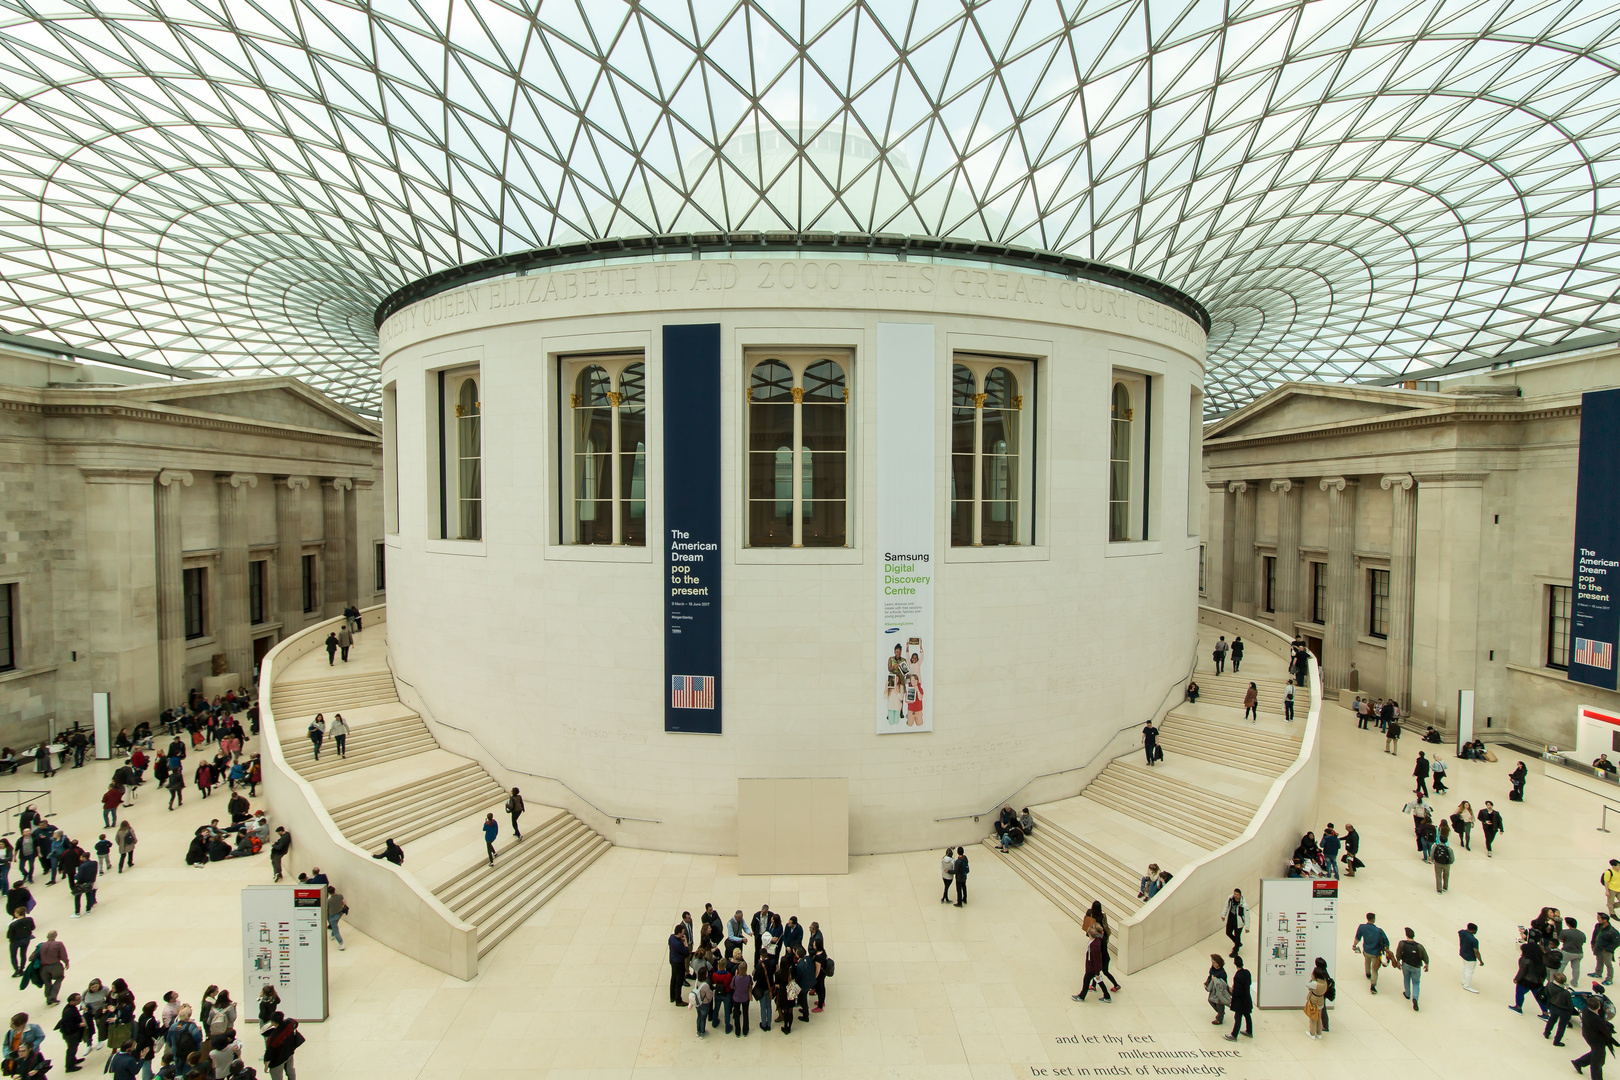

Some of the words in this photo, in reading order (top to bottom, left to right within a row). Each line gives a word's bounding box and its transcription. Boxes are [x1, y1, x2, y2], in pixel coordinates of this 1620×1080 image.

[423, 287, 481, 327] QUEEN
[489, 267, 642, 310] ELIZABETH
[655, 264, 677, 293] II
[689, 263, 739, 291] AD
[757, 261, 843, 290] 2000
[858, 263, 935, 293] THIS
[951, 269, 1047, 304] GREAT
[1059, 282, 1129, 319] COURT
[671, 529, 690, 539] The
[671, 541, 718, 551] American
[671, 552, 704, 562] Dream
[884, 552, 930, 563] Samsung
[1579, 548, 1596, 557] The
[1579, 557, 1620, 567] American
[671, 565, 691, 574] pop
[884, 563, 915, 574] Digital
[1579, 565, 1607, 575] Dream
[671, 575, 681, 584] to
[683, 575, 700, 584] the
[884, 575, 931, 585] Discovery
[1578, 575, 1596, 583] pop
[671, 587, 709, 597] present
[884, 586, 916, 595] Centre
[1578, 582, 1587, 590] to
[1588, 584, 1602, 592] the
[1578, 592, 1610, 602] present
[562, 723, 578, 736] The
[580, 725, 614, 740] Weston
[617, 728, 648, 745] Family
[1055, 1034, 1080, 1044] and
[1081, 1034, 1101, 1044] let
[1102, 1034, 1124, 1045] thy
[1127, 1033, 1156, 1043] feet
[1118, 1049, 1199, 1059] millenniums
[1198, 1048, 1243, 1058] hence
[1030, 1066, 1049, 1077] be
[1052, 1066, 1074, 1076] set
[1076, 1065, 1091, 1076] in
[1093, 1065, 1133, 1076] midst
[1135, 1064, 1151, 1075] of
[1152, 1064, 1228, 1077] knowledge
